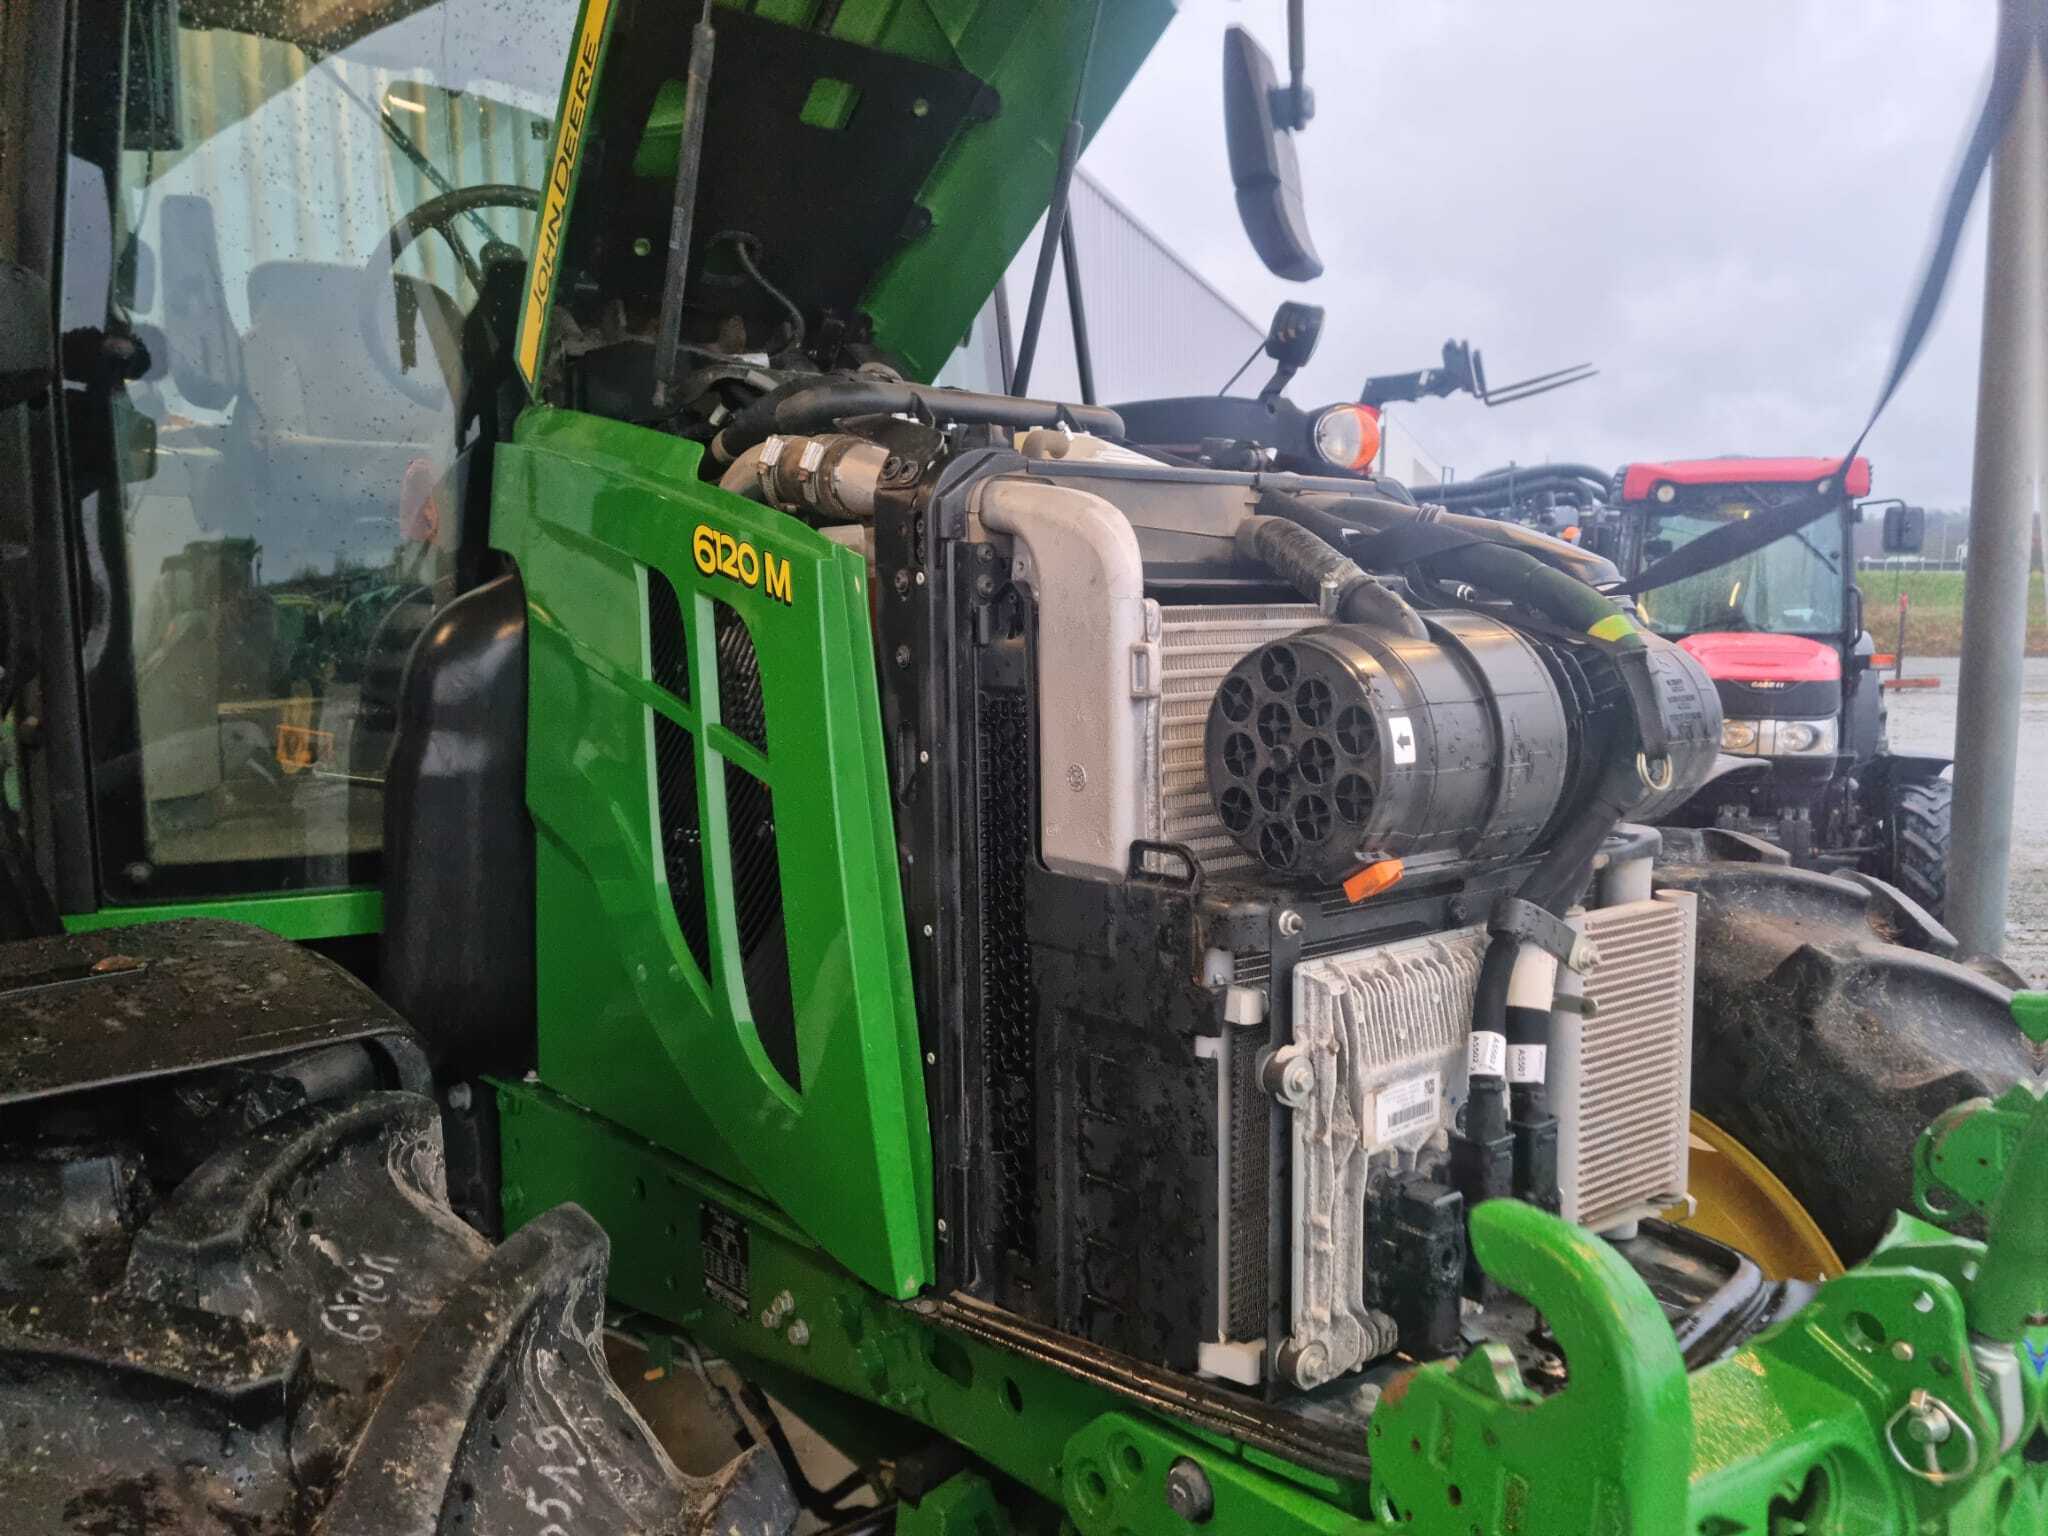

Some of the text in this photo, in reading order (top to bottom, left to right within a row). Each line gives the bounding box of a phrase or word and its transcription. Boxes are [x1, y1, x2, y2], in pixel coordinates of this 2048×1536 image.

[534, 32, 598, 323] JOHN DEERE
[692, 522, 793, 607] 6120 M
